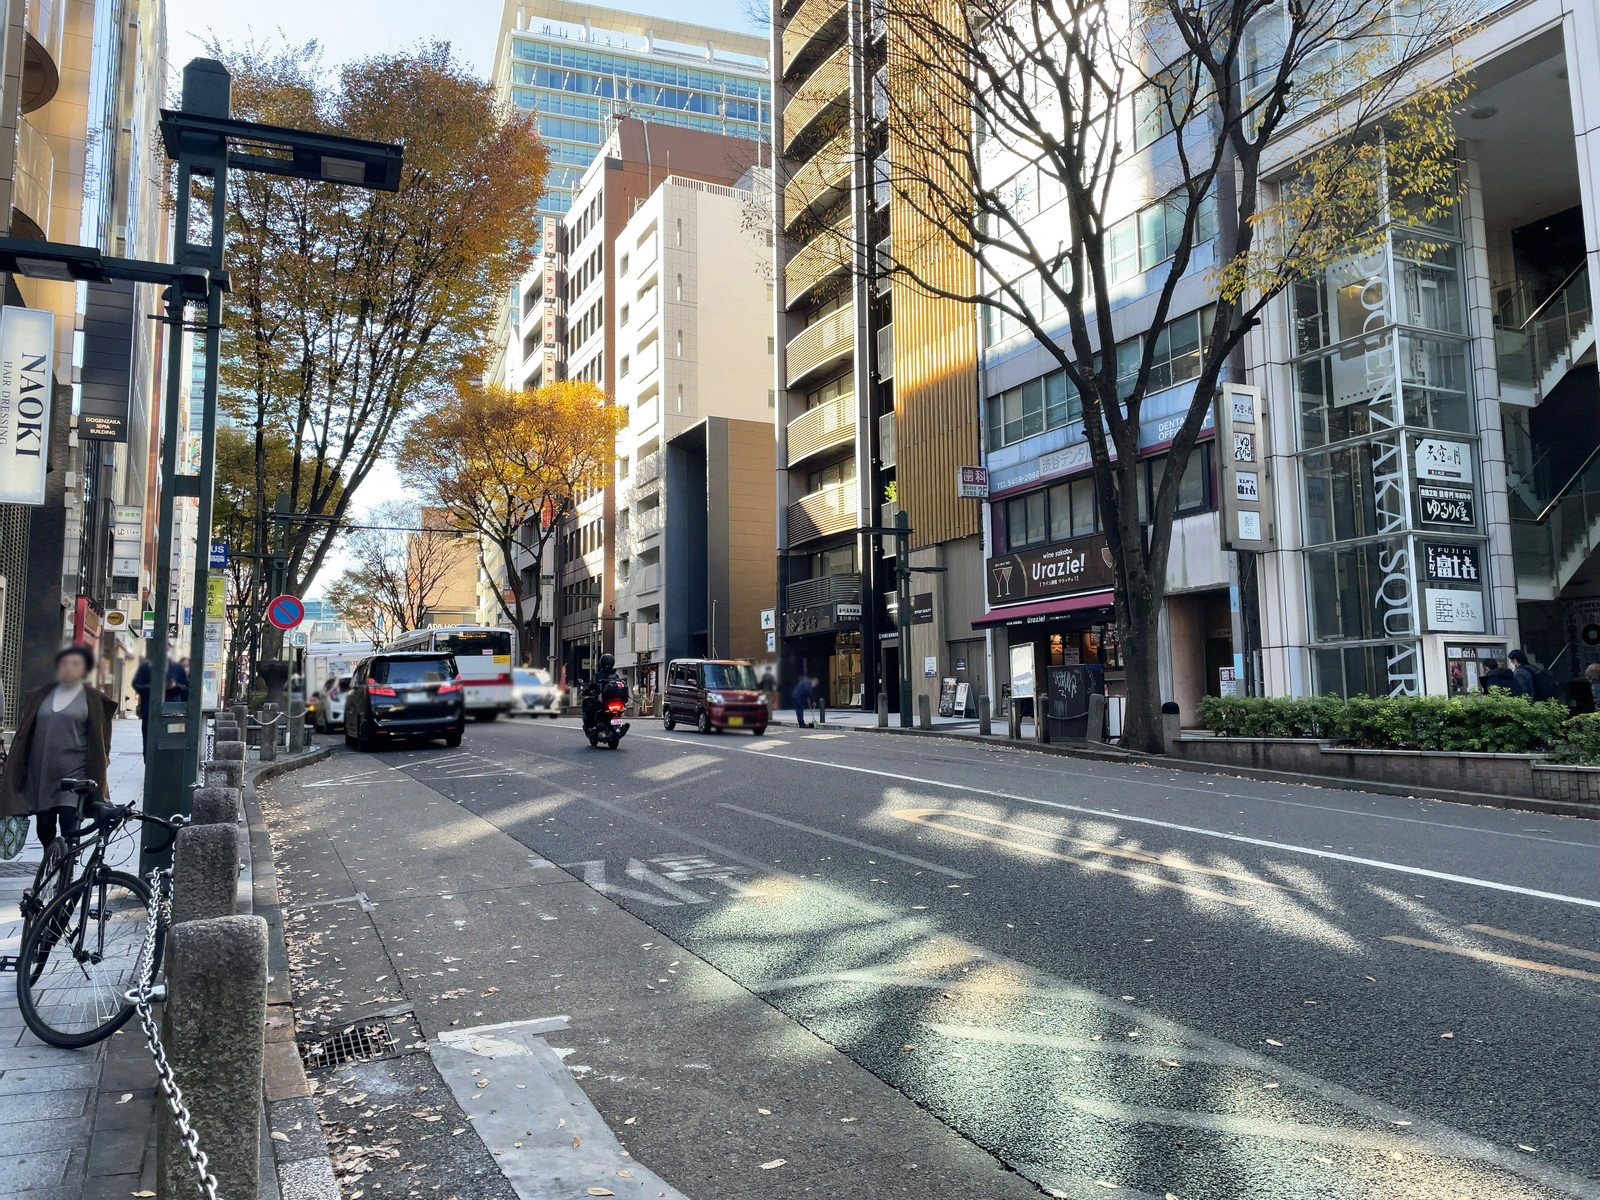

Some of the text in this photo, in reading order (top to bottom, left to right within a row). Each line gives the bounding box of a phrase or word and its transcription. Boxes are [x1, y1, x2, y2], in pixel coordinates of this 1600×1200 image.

[0, 361, 13, 445] HAIR DRESSING
[15, 352, 47, 458] NAOKI
[85, 417, 121, 425] DOGENZAKA
[1158, 415, 1188, 432] DENTA
[1426, 444, 1462, 466] 天空の月
[963, 469, 986, 483] 歯科
[1358, 243, 1418, 699] DOGENZAKA SQUAR
[979, 486, 987, 496] 2F
[996, 481, 1008, 489] TEL
[1426, 499, 1471, 521] ゆるり屋
[210, 545, 225, 554] US
[1042, 548, 1073, 559] wine sakaba
[1032, 553, 1085, 580] Urazie!
[1428, 547, 1437, 577] とんかつ
